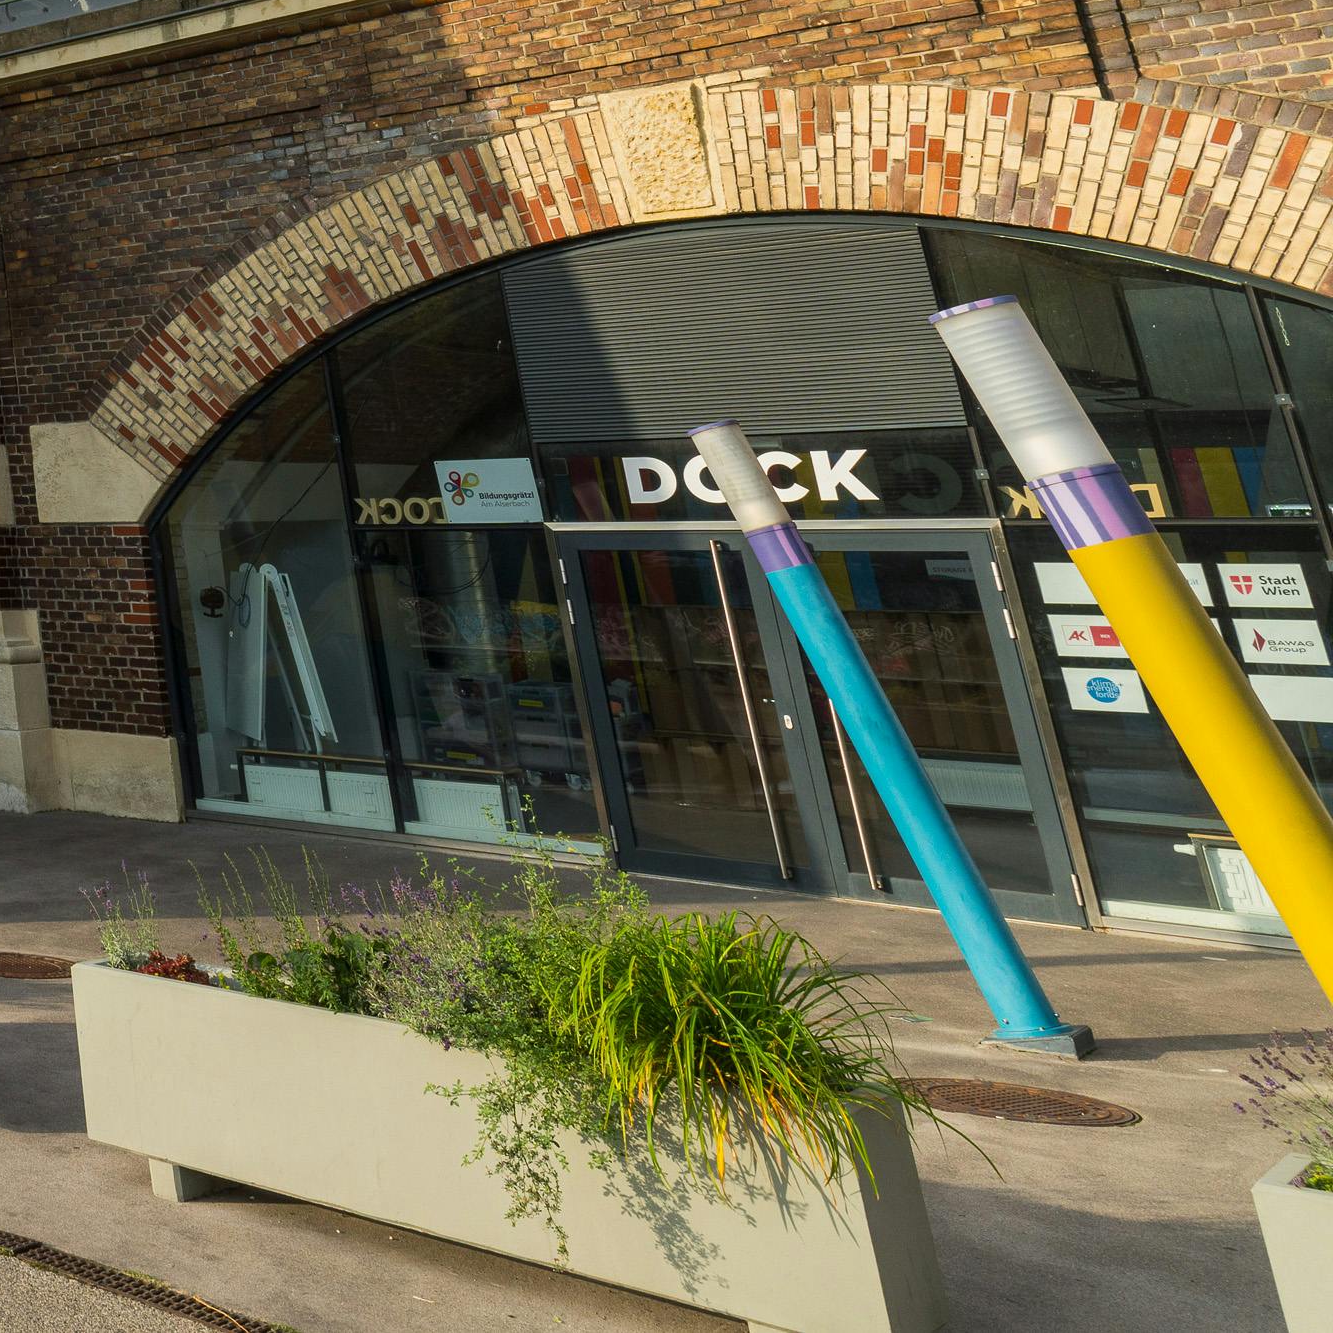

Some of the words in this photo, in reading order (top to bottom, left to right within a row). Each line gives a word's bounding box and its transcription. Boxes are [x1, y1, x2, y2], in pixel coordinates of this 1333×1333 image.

[479, 491, 535, 500] Bildungsgrätzl
[1259, 576, 1297, 585] Stadt
[1261, 587, 1301, 596] Wien
